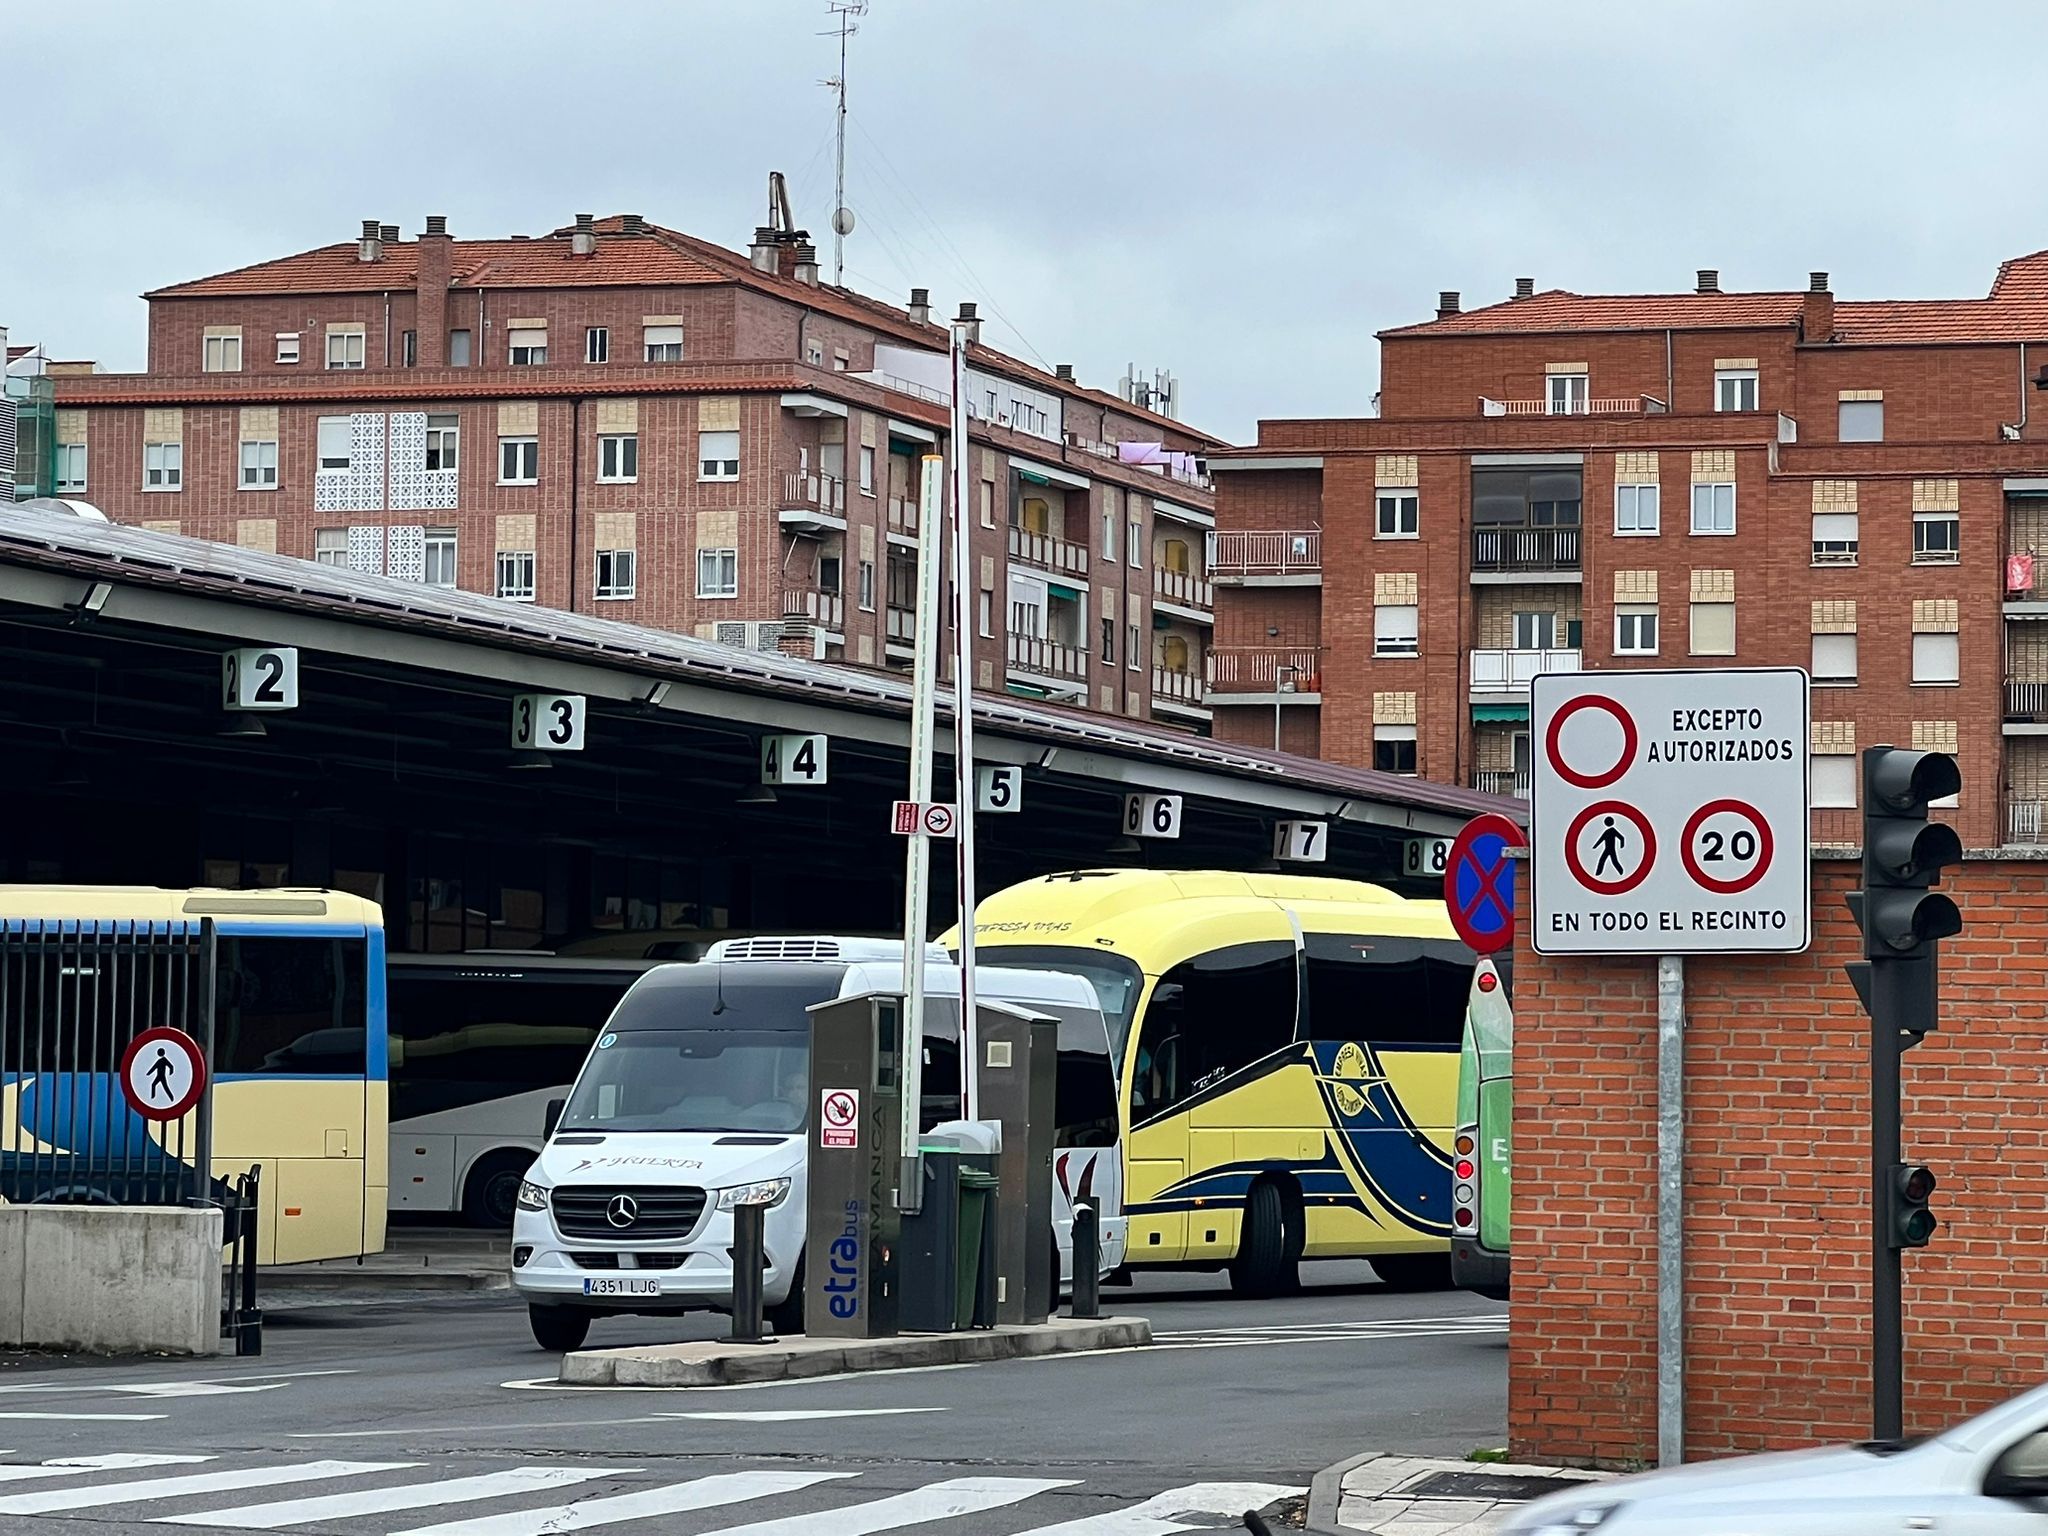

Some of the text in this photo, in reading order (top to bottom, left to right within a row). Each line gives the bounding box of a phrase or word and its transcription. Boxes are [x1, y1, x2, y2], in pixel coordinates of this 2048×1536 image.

[227, 654, 237, 704] 2
[255, 653, 284, 702] 2
[518, 699, 530, 743] 3
[548, 700, 573, 744] 3
[1672, 708, 1762, 732] EXCEPTO
[765, 739, 777, 780] 4
[793, 739, 817, 779] 4
[1647, 739, 1794, 763] AUTORIZADOS
[989, 770, 1011, 807] 5
[1128, 796, 1140, 831] 6
[1152, 798, 1172, 832] 6
[1280, 824, 1289, 855] 7
[1301, 824, 1319, 856] 7
[1408, 841, 1419, 871] 8
[1431, 841, 1447, 871] 8
[1701, 830, 1756, 861] 20
[1552, 910, 1786, 931] EN TODO EL RECINTO
[591, 1280, 656, 1293] 4351 LJG
